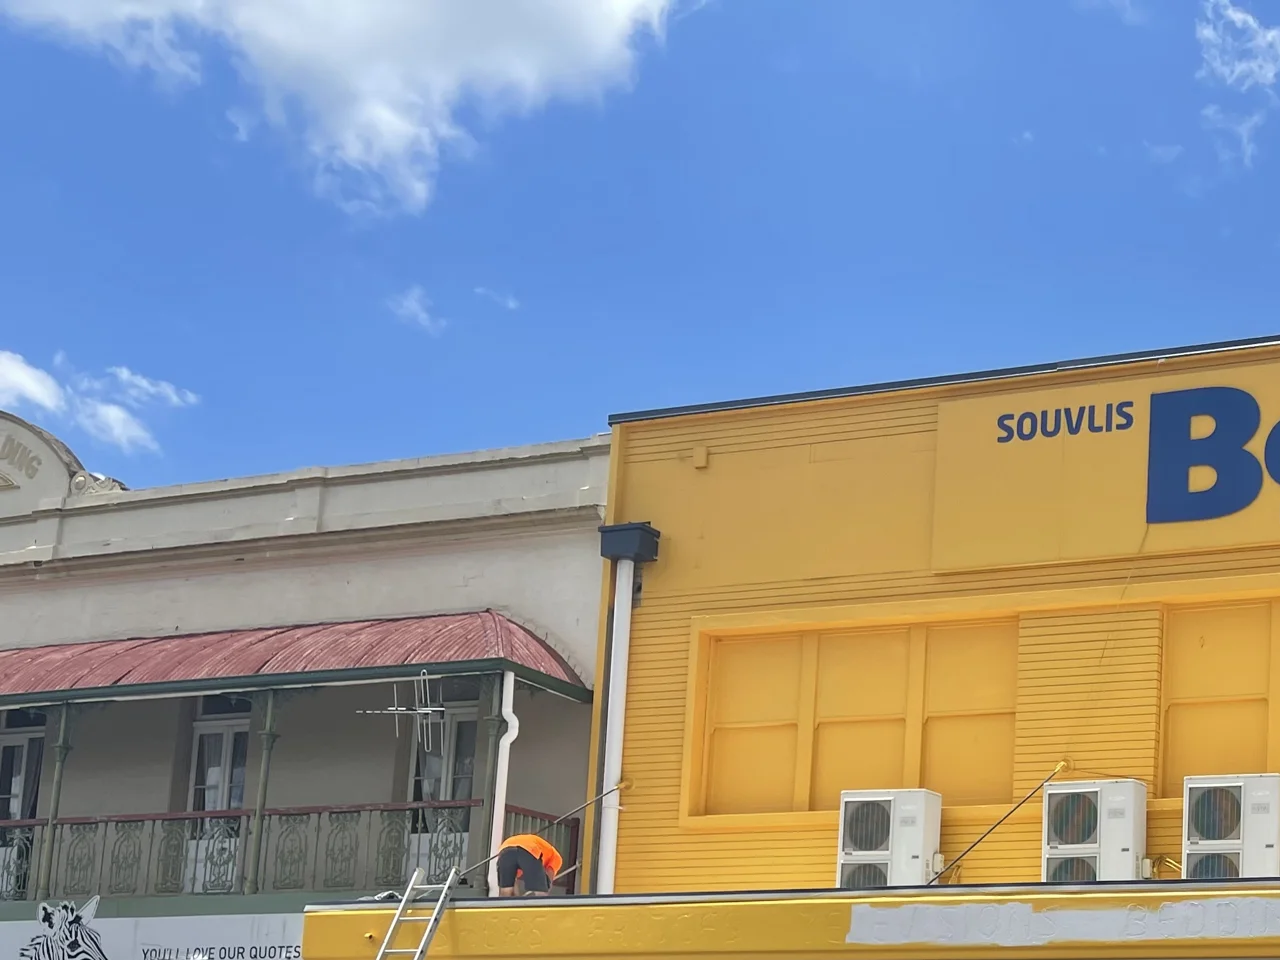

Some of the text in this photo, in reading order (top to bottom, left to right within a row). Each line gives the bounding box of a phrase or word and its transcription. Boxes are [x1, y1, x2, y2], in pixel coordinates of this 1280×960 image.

[997, 401, 1134, 443] SOUVLIS
[218, 946, 245, 960] OUR
[249, 945, 301, 960] QUOTES
